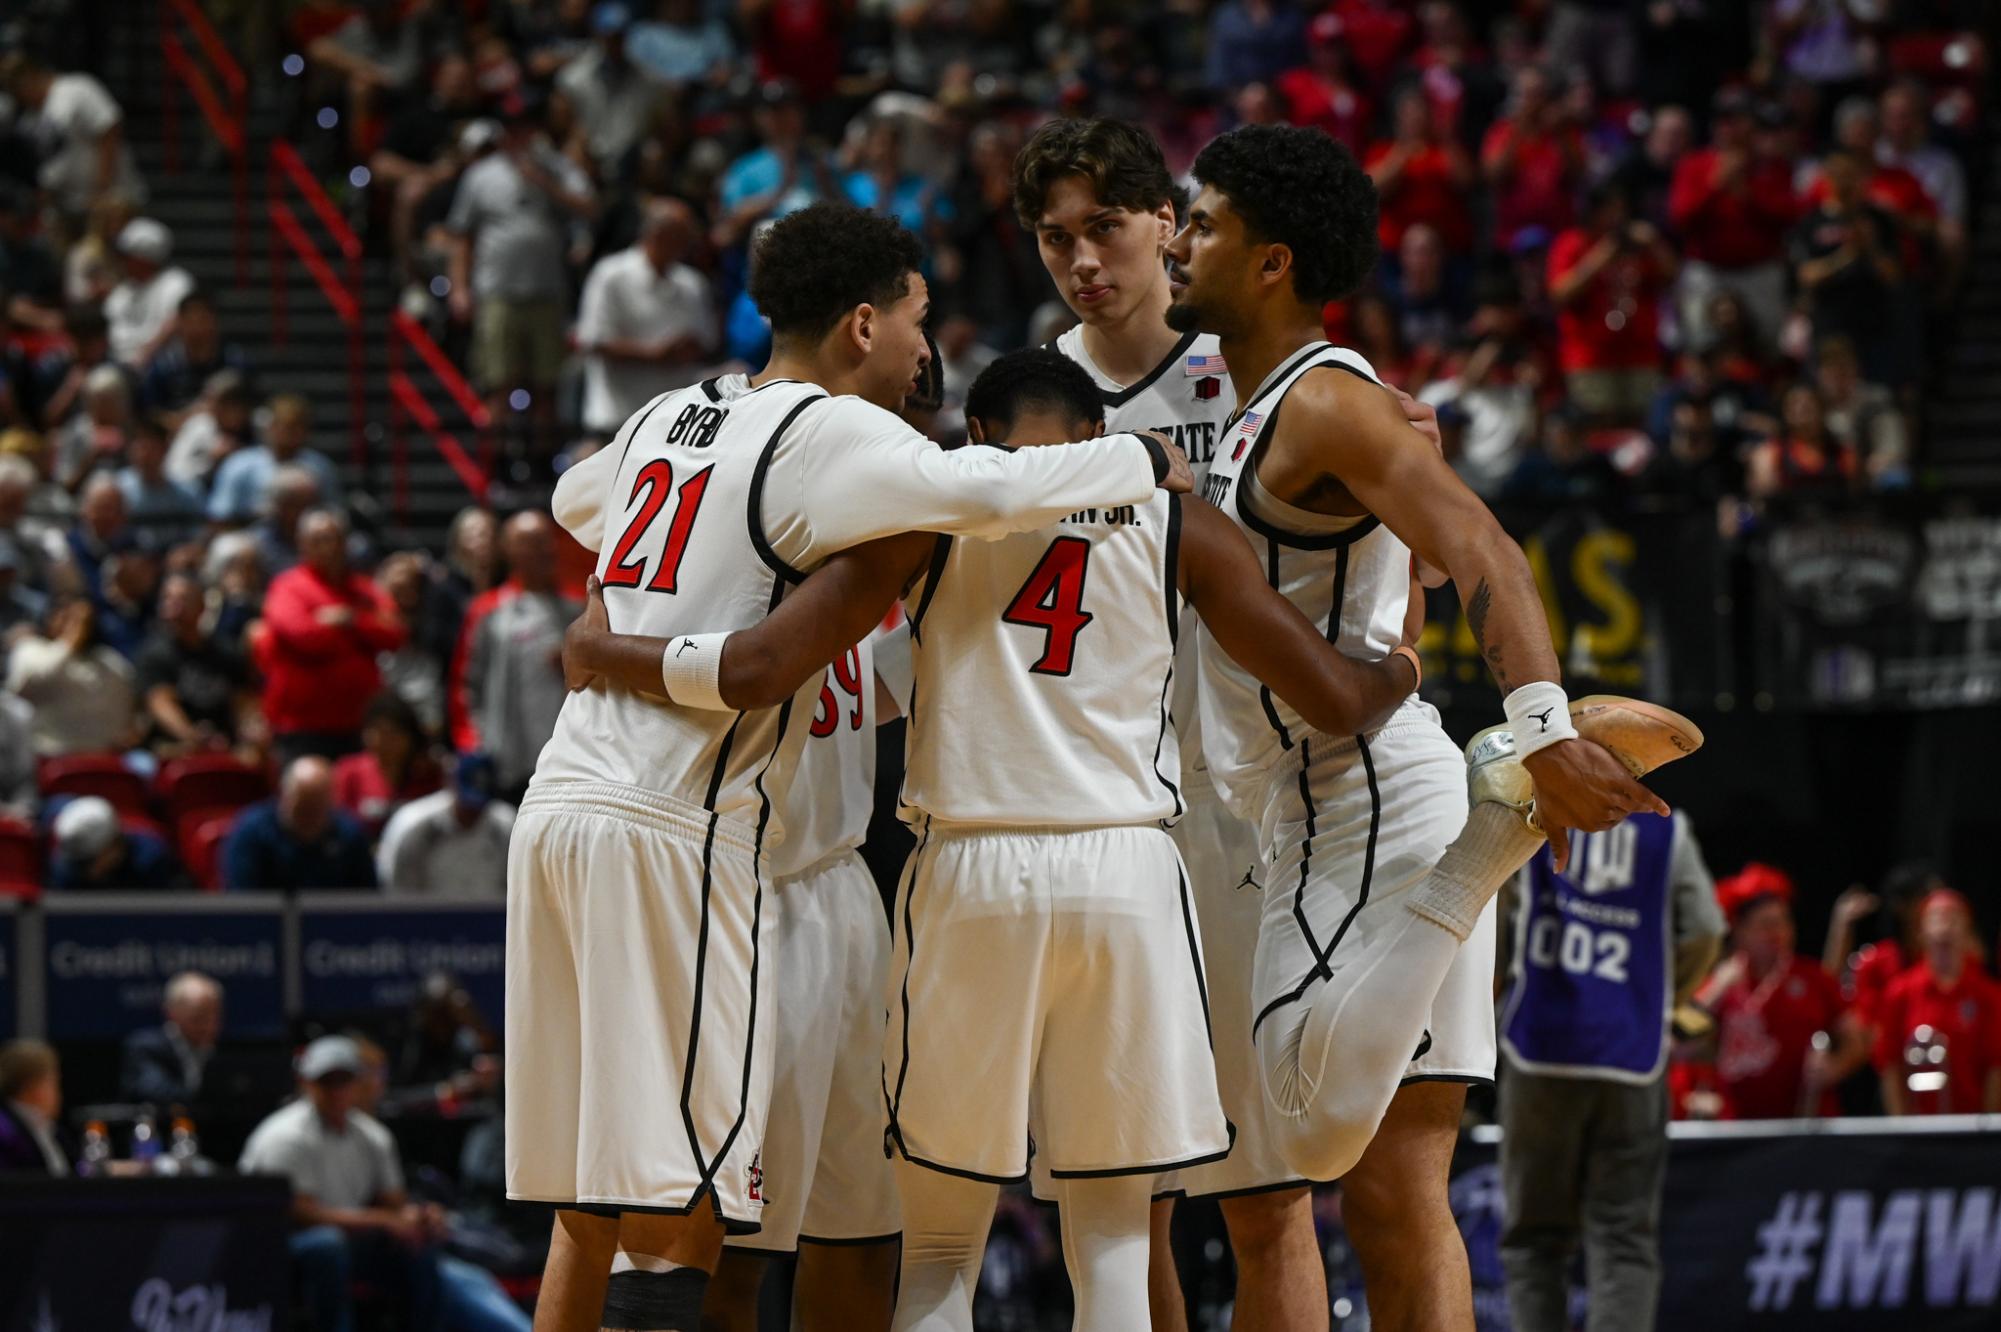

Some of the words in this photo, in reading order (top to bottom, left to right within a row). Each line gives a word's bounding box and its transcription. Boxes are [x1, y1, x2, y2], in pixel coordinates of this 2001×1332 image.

[666, 403, 729, 448] BYRD
[1149, 422, 1216, 463] ATE
[602, 458, 716, 596] 21
[1002, 535, 1094, 677] 4
[52, 939, 153, 978] Credit
[156, 939, 253, 978] Union
[305, 938, 402, 977] Credit
[1528, 914, 1632, 984] 002
